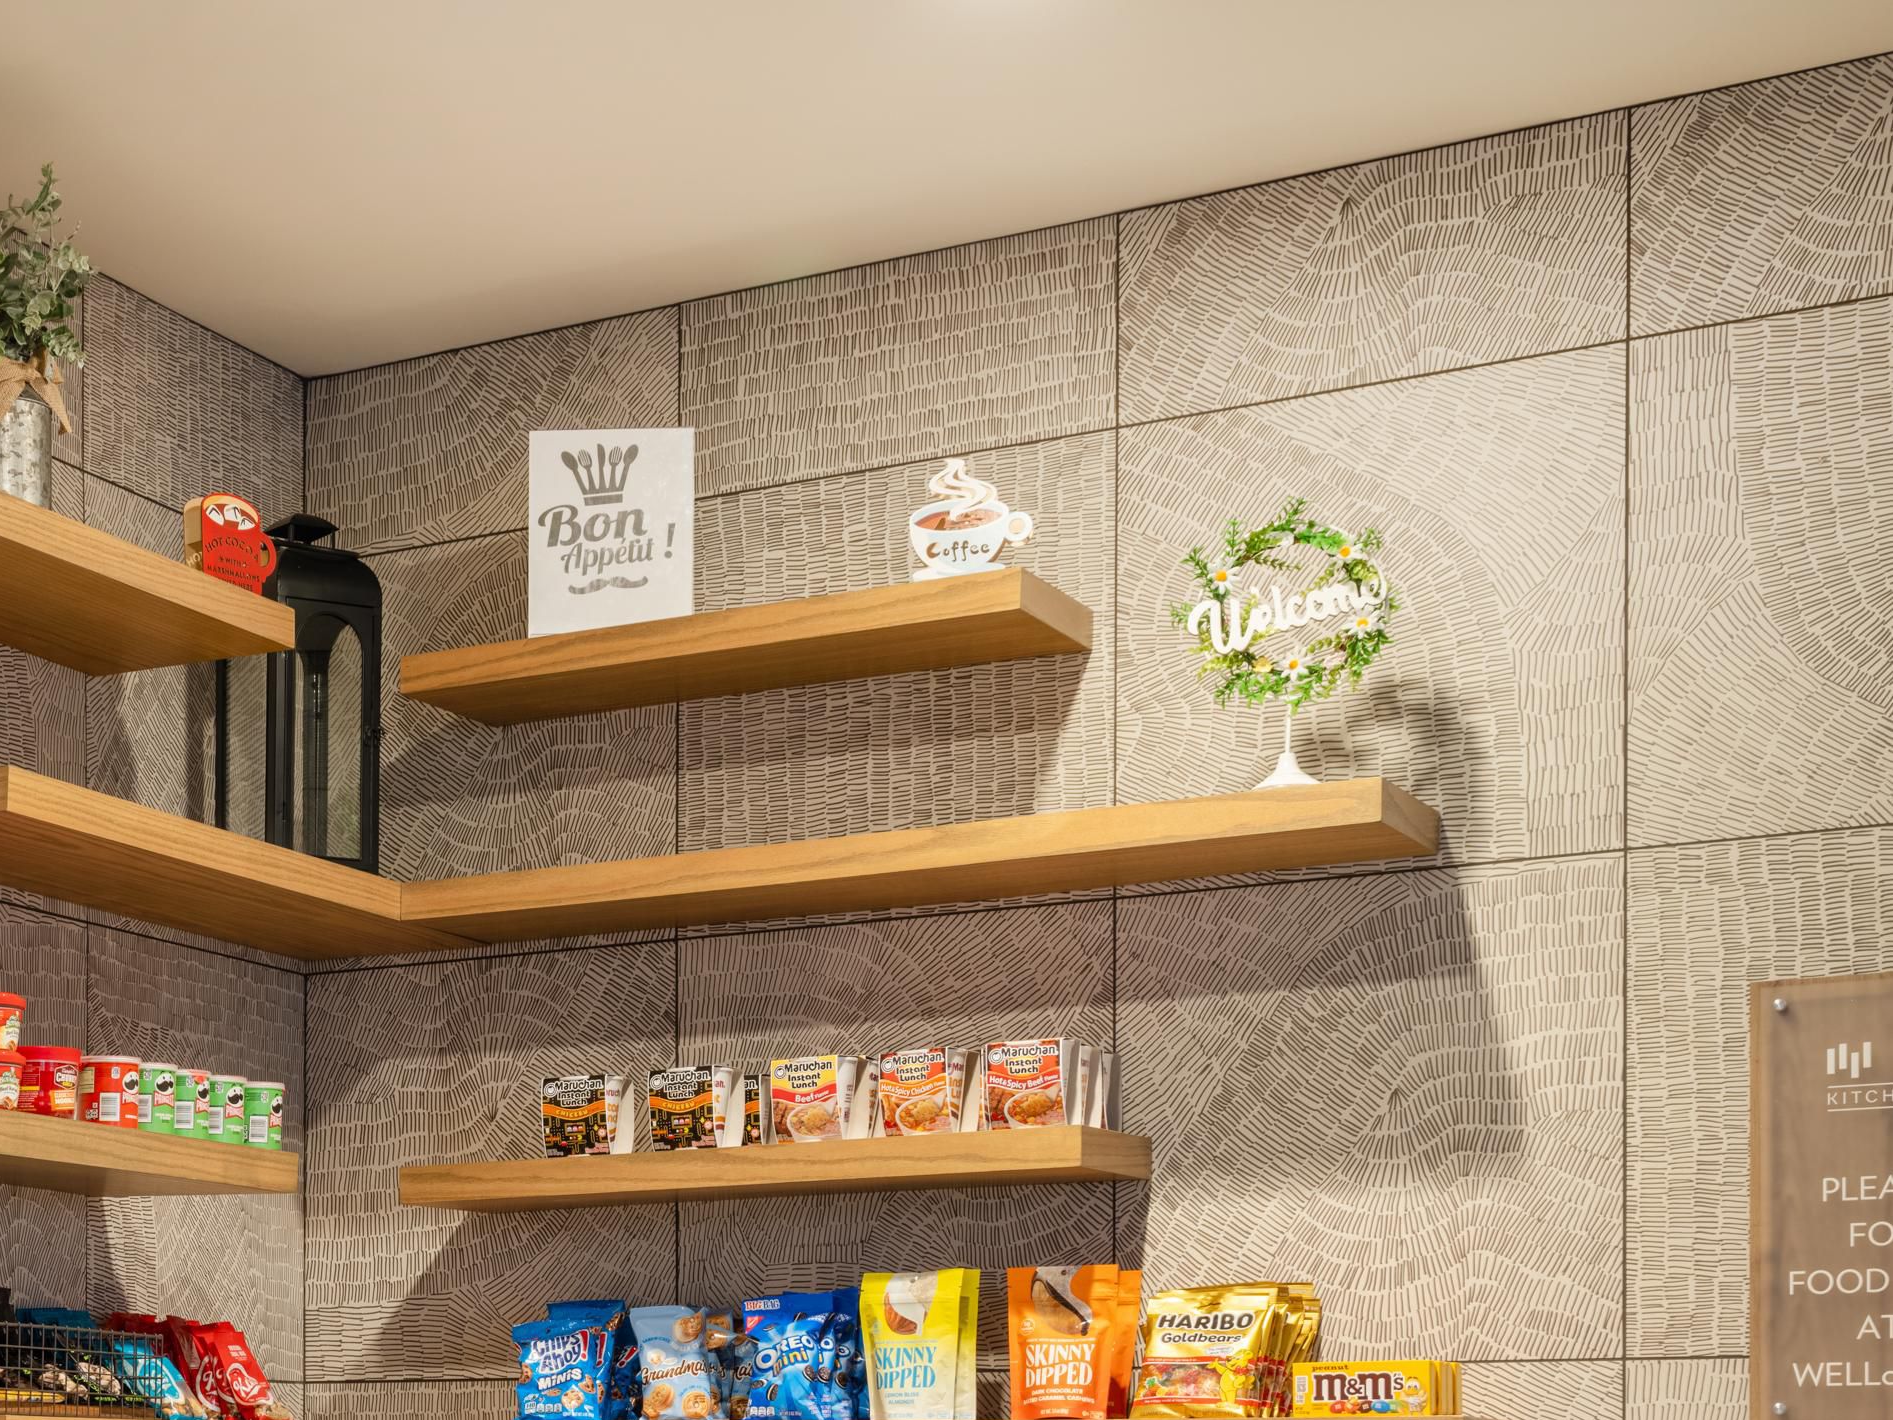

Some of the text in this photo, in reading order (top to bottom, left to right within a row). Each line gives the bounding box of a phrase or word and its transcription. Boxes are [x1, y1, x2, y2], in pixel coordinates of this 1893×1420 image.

[537, 504, 647, 547] Bon
[561, 536, 654, 577] Appétit
[926, 540, 991, 562] Coffee
[1187, 577, 1387, 654] Welcome
[1001, 1045, 1057, 1059] Maruchan
[784, 1061, 833, 1073] Maruchan
[892, 1053, 942, 1067] Maruchan
[1005, 1056, 1043, 1068] Instant
[895, 1063, 931, 1075] Instant
[1009, 1065, 1039, 1074] Lunch
[661, 1070, 709, 1084] Maruchan
[787, 1072, 821, 1082] Instant
[899, 1072, 927, 1082] Lunch
[555, 1080, 602, 1092] Maruchan
[664, 1081, 698, 1092] Instant
[791, 1080, 818, 1089] Lunch
[557, 1091, 590, 1100] Instant
[668, 1090, 694, 1099] Lunch
[560, 1098, 587, 1107] Lunch
[1789, 1269, 1889, 1296] FOOD
[1157, 1312, 1256, 1331] HARIBO
[1161, 1332, 1243, 1346] Goldbears
[755, 1334, 815, 1369] OREO
[875, 1347, 937, 1370] SKINNY
[1025, 1342, 1095, 1365] SKINNY
[876, 1371, 936, 1390] DIPPED
[1025, 1366, 1092, 1387] DIPPED
